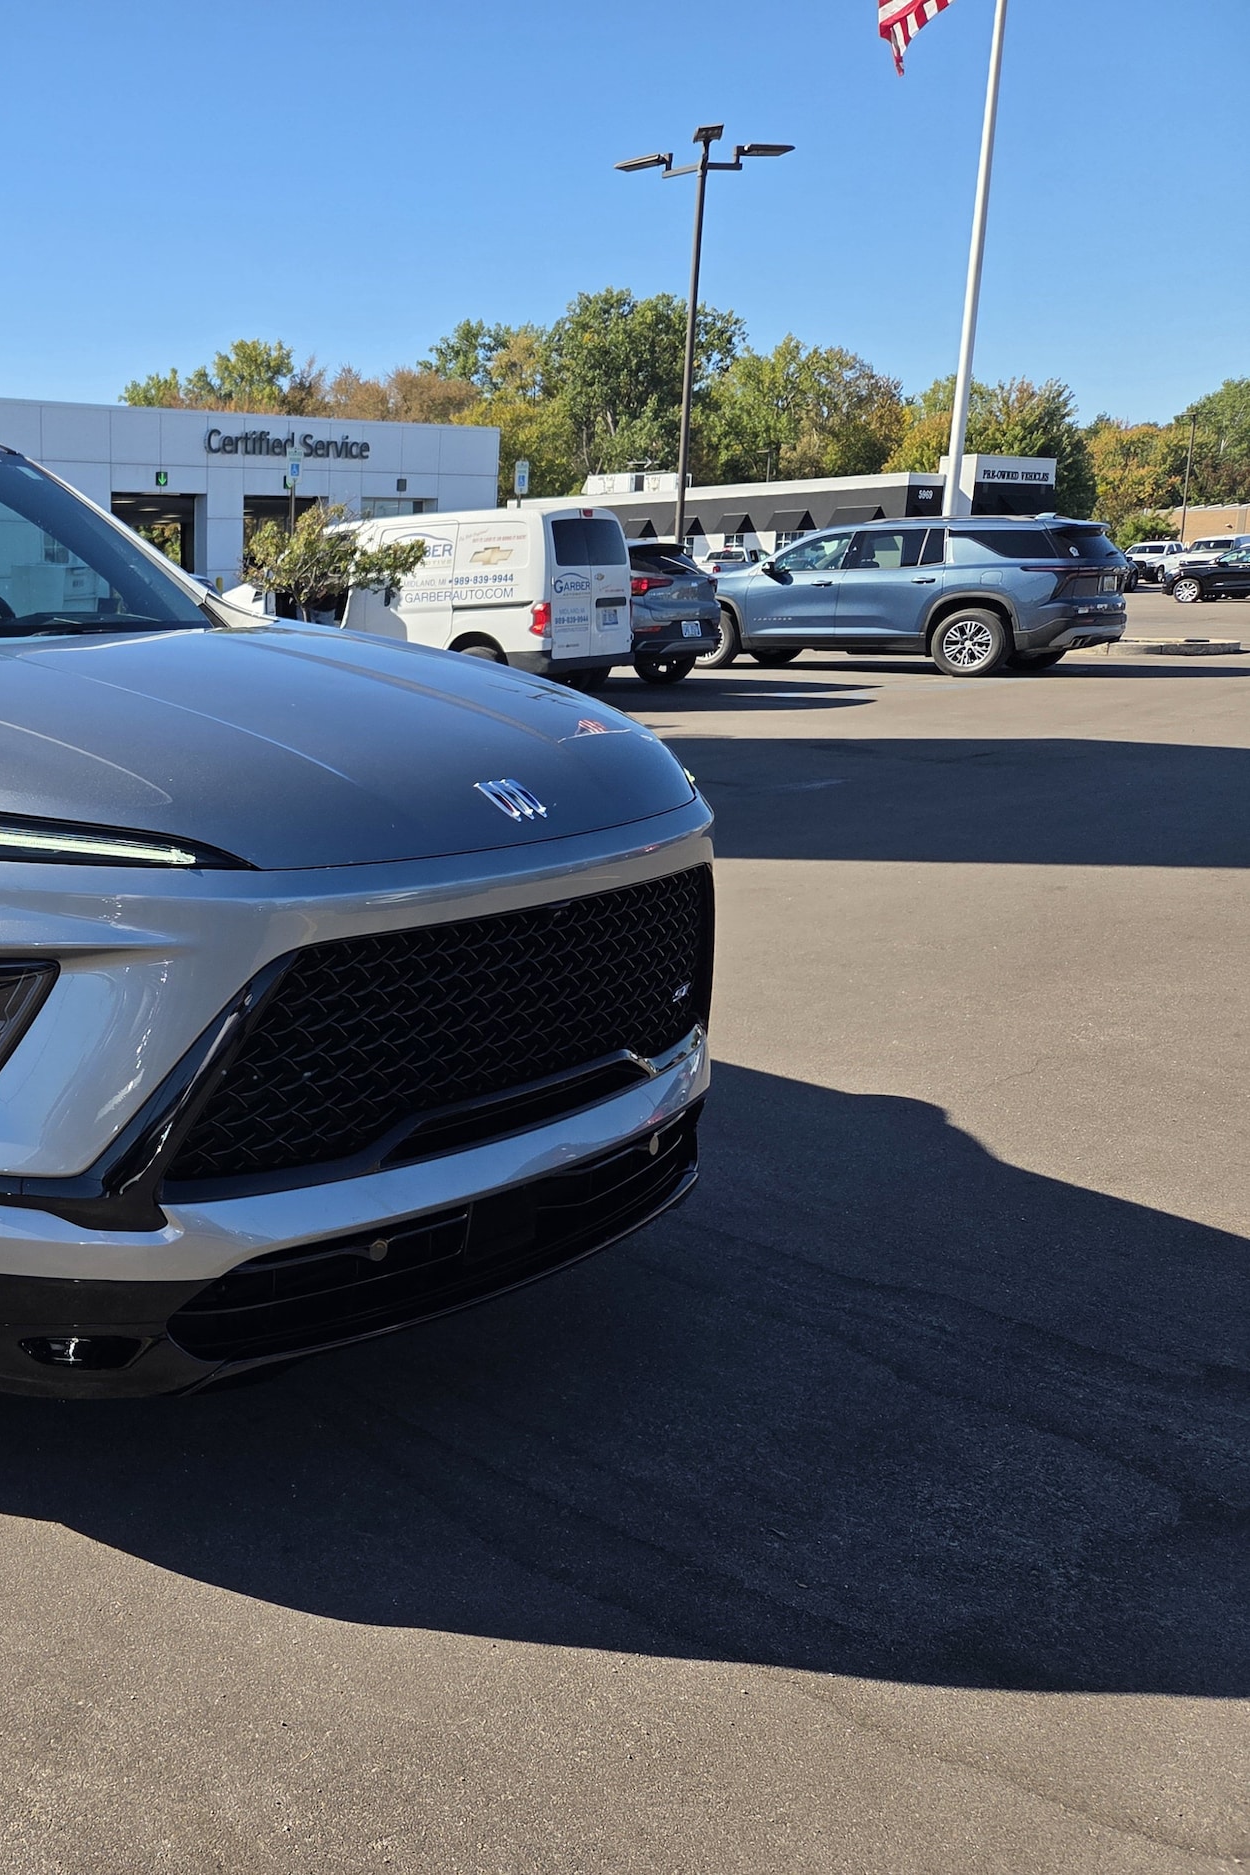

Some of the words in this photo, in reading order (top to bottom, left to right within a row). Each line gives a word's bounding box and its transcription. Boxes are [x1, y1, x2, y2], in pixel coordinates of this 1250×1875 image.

[205, 428, 295, 456] Certified
[301, 433, 370, 459] Service
[982, 469, 1019, 480] PRE-OWNED
[1021, 471, 1049, 481] VEHICLES
[454, 573, 514, 586] 989-839-9944
[554, 579, 590, 594] GARBER
[404, 587, 514, 604] GARBERAUTO.COM
